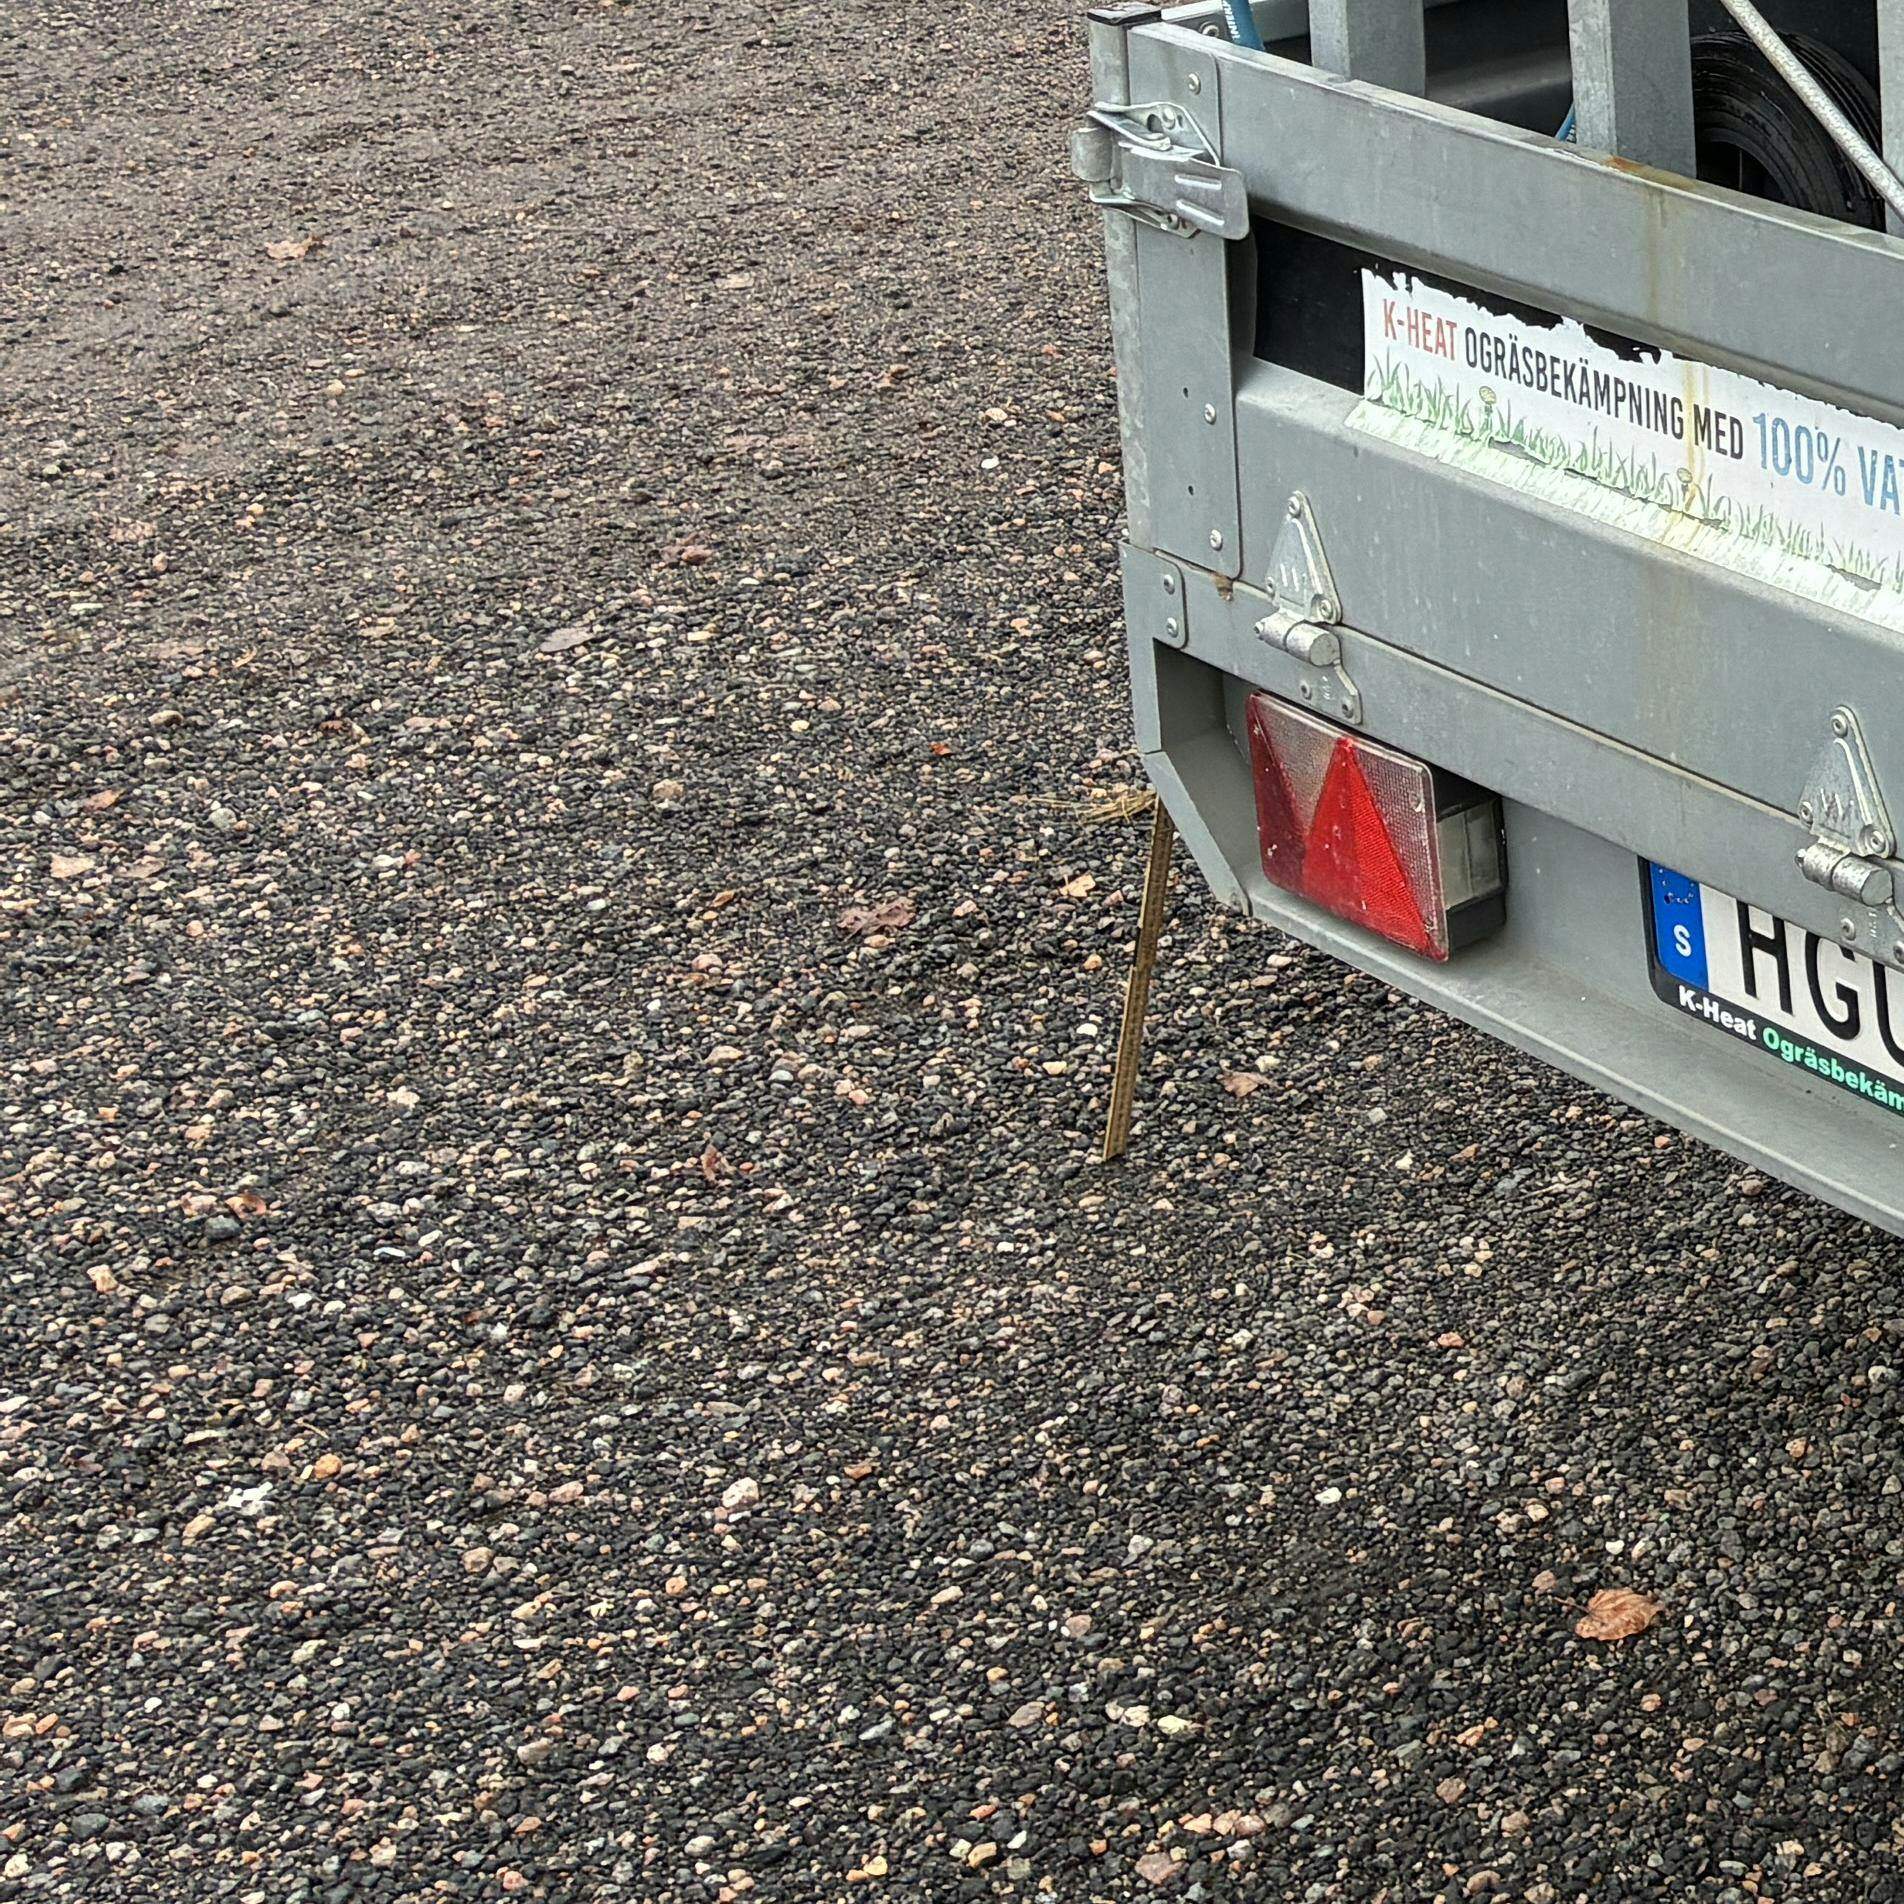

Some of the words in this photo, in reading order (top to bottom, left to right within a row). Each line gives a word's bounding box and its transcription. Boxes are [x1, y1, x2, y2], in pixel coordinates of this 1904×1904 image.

[1383, 298, 1457, 362] K-HEAT
[1464, 325, 1684, 441] OGRÄSBEKÄMPNING
[1693, 403, 1744, 461] MED
[1752, 411, 1846, 497] 100%
[1673, 924, 1692, 958] S
[1679, 984, 1757, 1042] K-Heat
